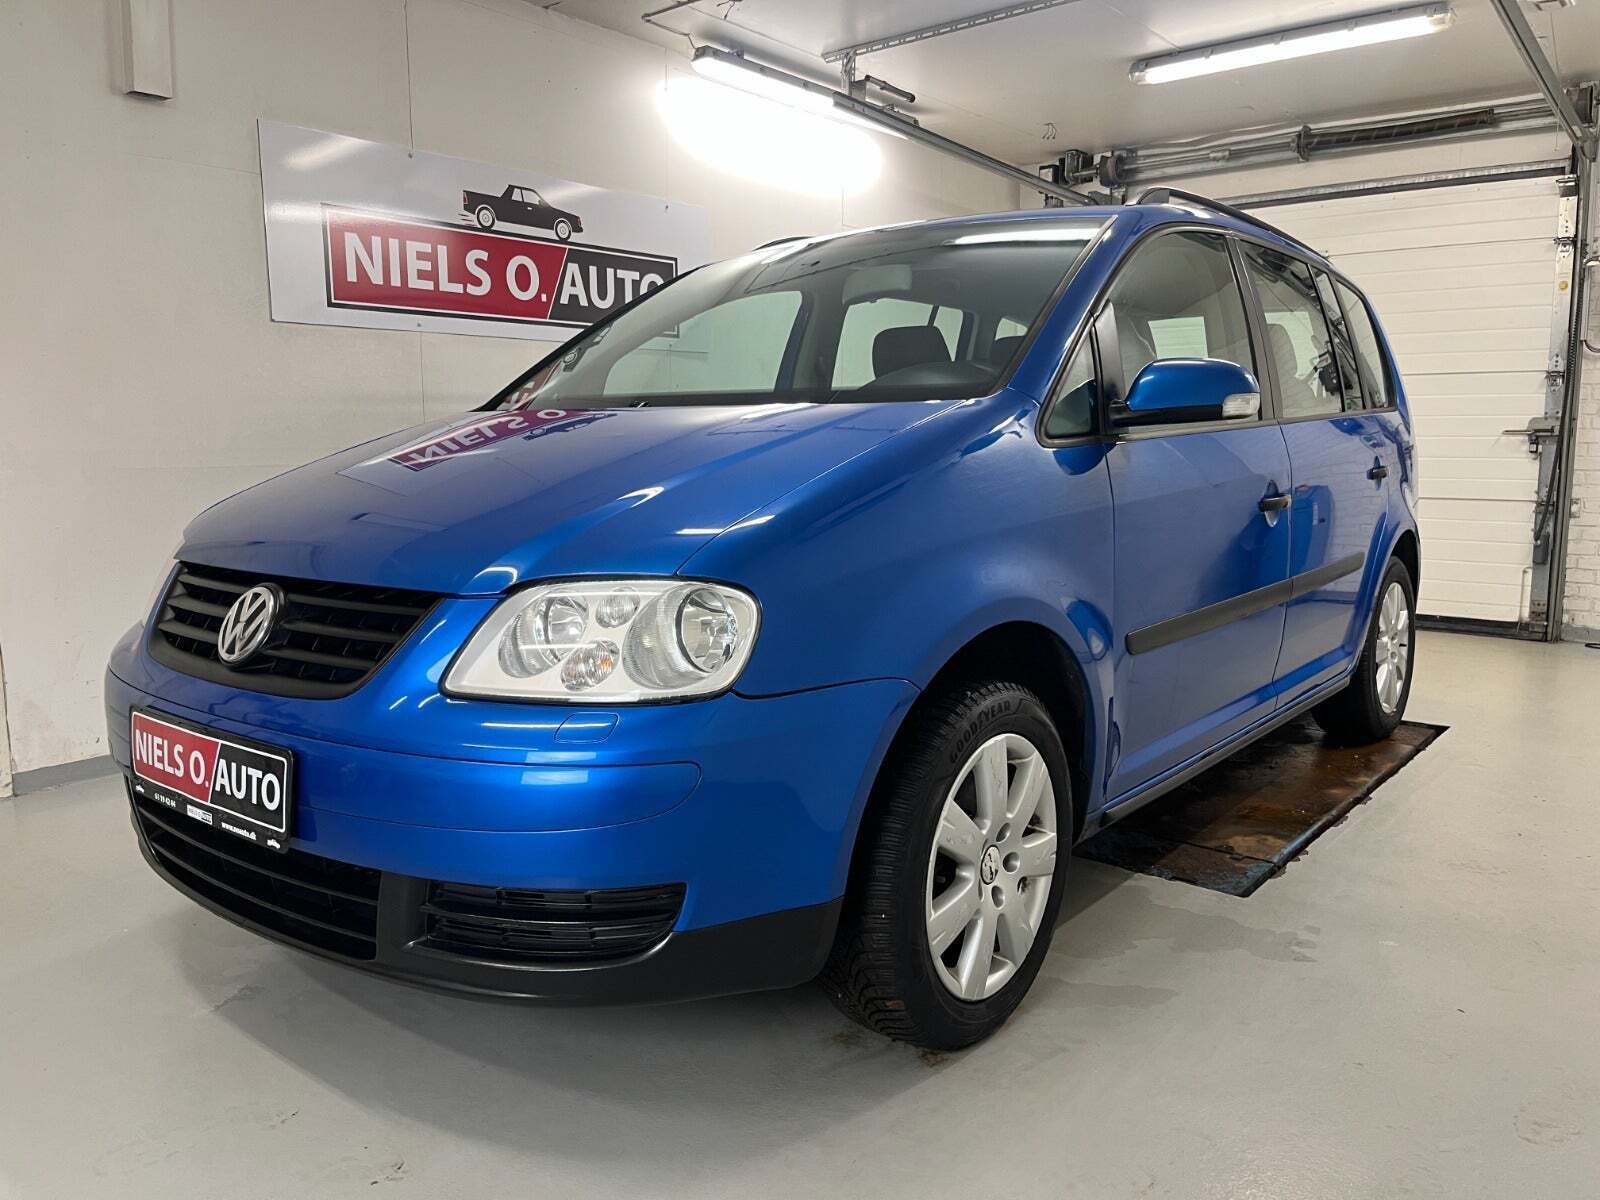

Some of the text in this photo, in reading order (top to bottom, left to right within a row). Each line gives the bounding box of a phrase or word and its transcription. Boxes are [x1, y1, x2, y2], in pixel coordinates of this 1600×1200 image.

[344, 231, 492, 297] NIELS
[506, 255, 547, 303] O.
[950, 700, 1011, 764] GOODYEAR
[135, 728, 281, 811] NIELS O. AUTO
